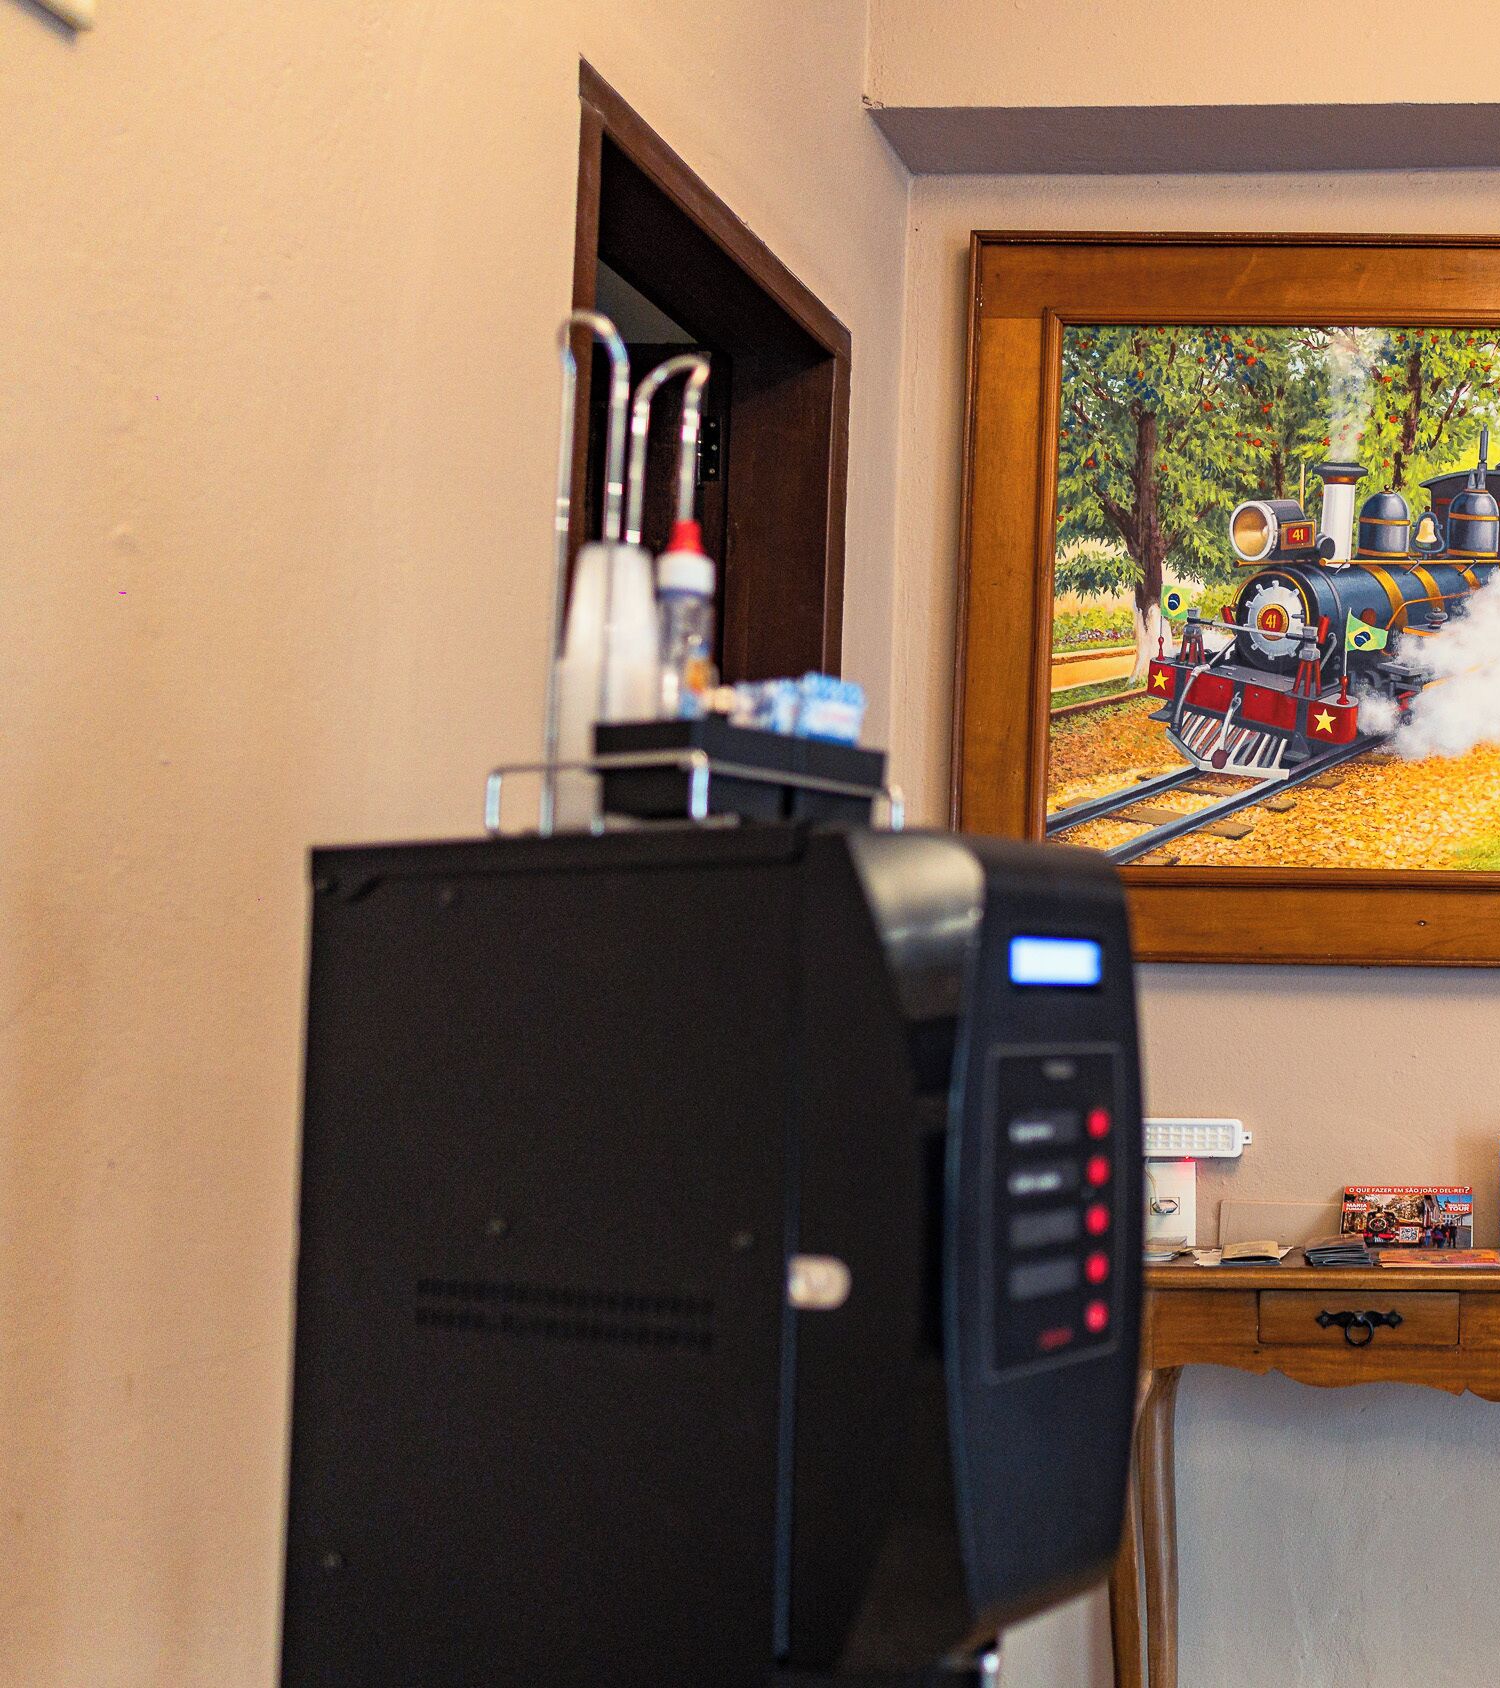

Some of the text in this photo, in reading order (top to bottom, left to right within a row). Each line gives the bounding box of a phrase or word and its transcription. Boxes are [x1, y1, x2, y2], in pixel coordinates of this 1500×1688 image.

[1292, 529, 1304, 541] 41
[1265, 614, 1277, 629] 41
[1420, 1186, 1438, 1194] JOÃO
